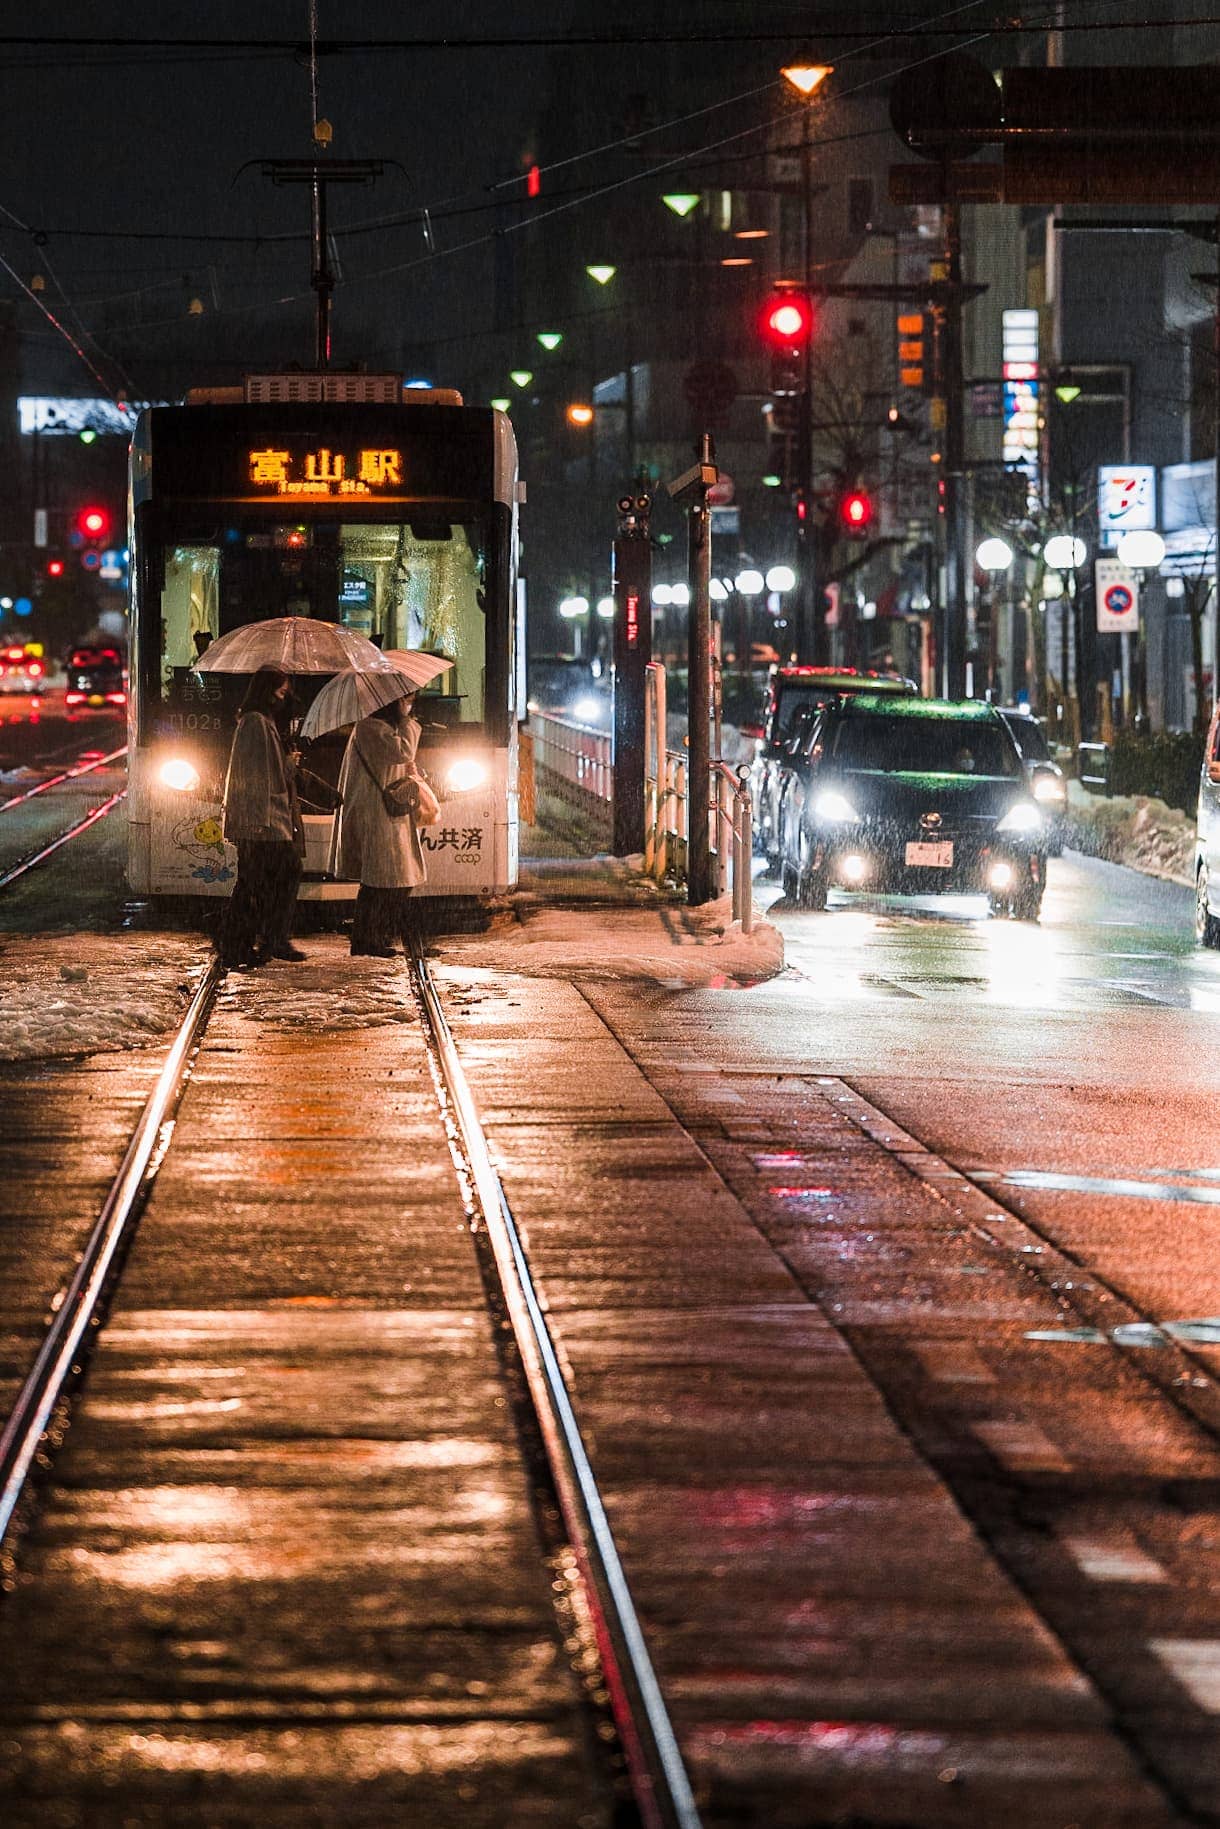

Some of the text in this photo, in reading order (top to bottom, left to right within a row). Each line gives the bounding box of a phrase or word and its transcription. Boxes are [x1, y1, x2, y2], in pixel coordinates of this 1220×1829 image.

[250, 449, 401, 482] 富山駅
[279, 480, 328, 492] Toyama
[419, 828, 482, 850] ん共済
